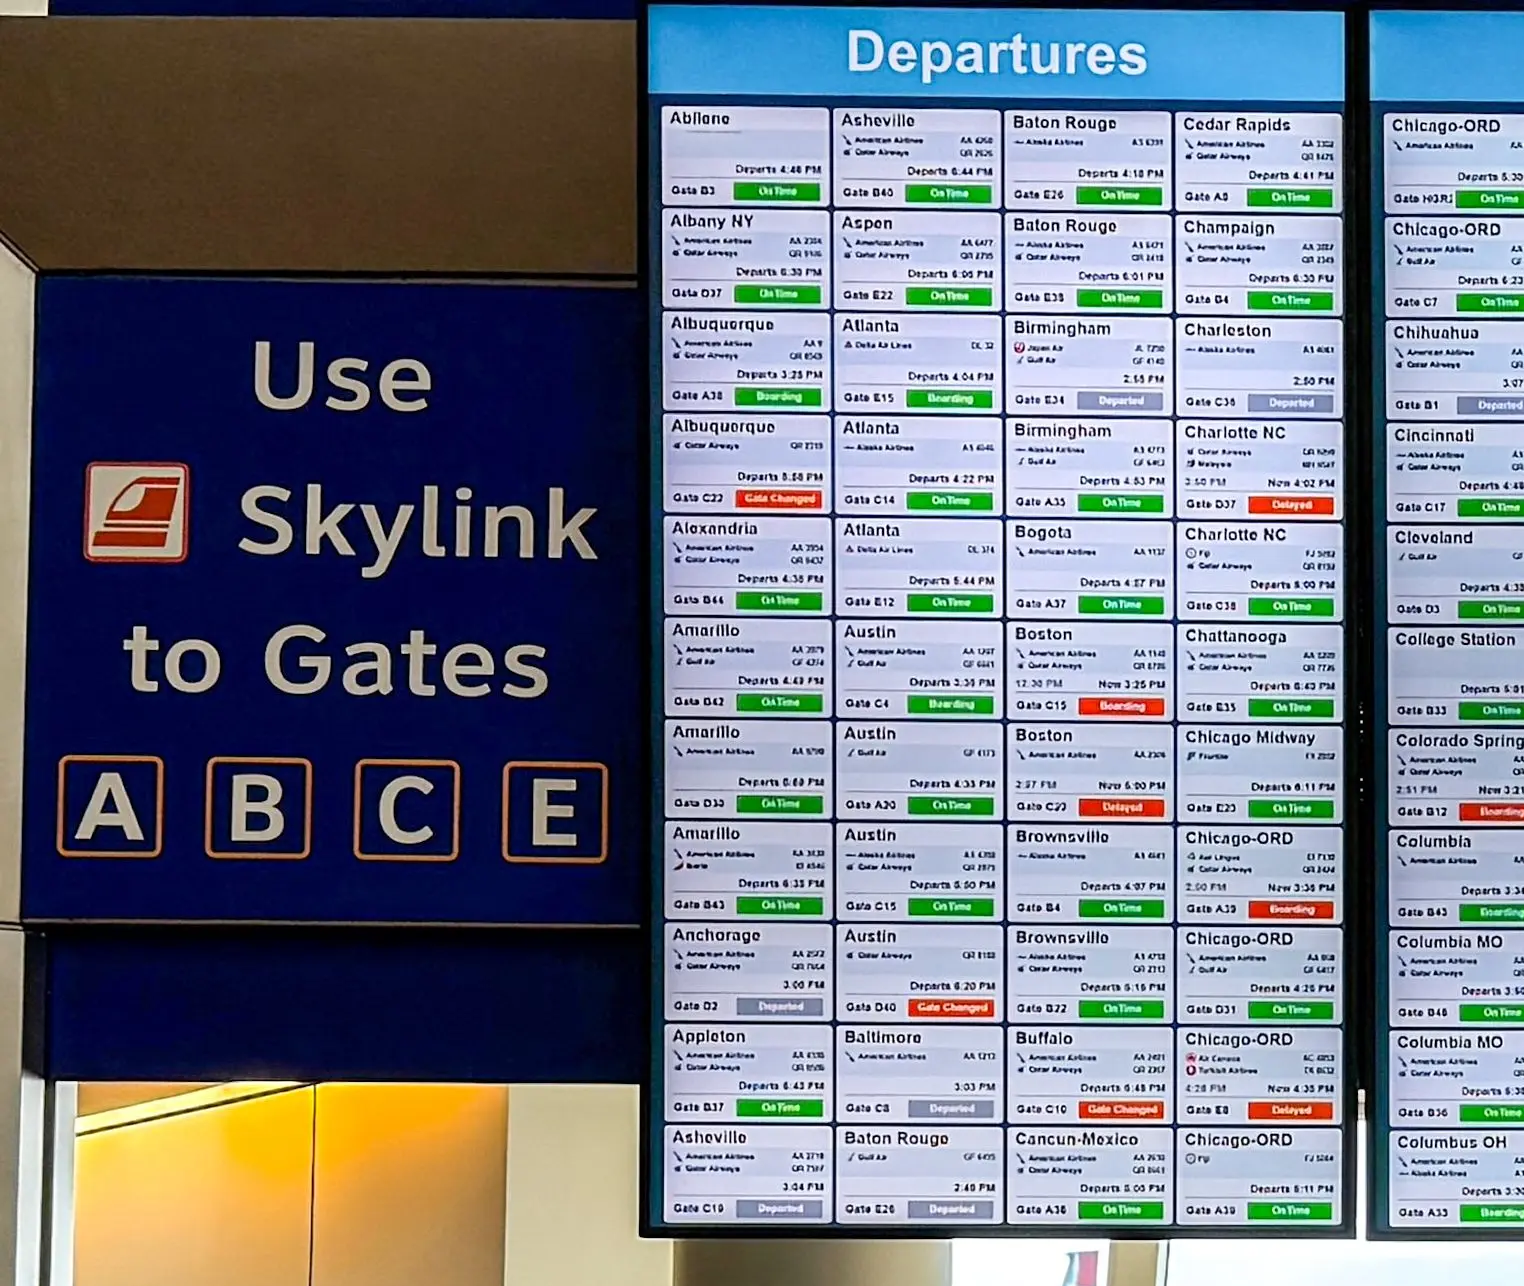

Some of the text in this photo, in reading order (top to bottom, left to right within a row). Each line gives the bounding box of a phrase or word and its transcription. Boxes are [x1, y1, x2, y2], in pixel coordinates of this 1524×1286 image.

[849, 30, 1146, 83] Departures
[671, 214, 753, 230] Albany NY
[842, 216, 892, 231] Aspen
[1184, 221, 1274, 236] Champaign
[255, 341, 431, 411] Use
[843, 421, 899, 434] Atlanta
[1015, 423, 1111, 440] Birmingham
[1395, 429, 1473, 442] Cincinnati
[239, 484, 597, 578] Skylink
[672, 521, 757, 534] Alexandria
[1016, 525, 1071, 541] Bogota
[1396, 633, 1515, 648] College Station
[123, 625, 548, 697] to Gates
[844, 727, 895, 739] Austin
[1016, 729, 1072, 741] Boston
[1186, 730, 1315, 746] Chicago Midway
[75, 773, 577, 846] A B C E
[1397, 835, 1471, 847] Columbia
[673, 928, 760, 944] Anchorage
[673, 1029, 745, 1045] Appleton
[1016, 1032, 1072, 1044] Buffalo
[1186, 1033, 1292, 1048] Chicago-ORD
[1016, 1132, 1138, 1145] Cancun-Mexico
